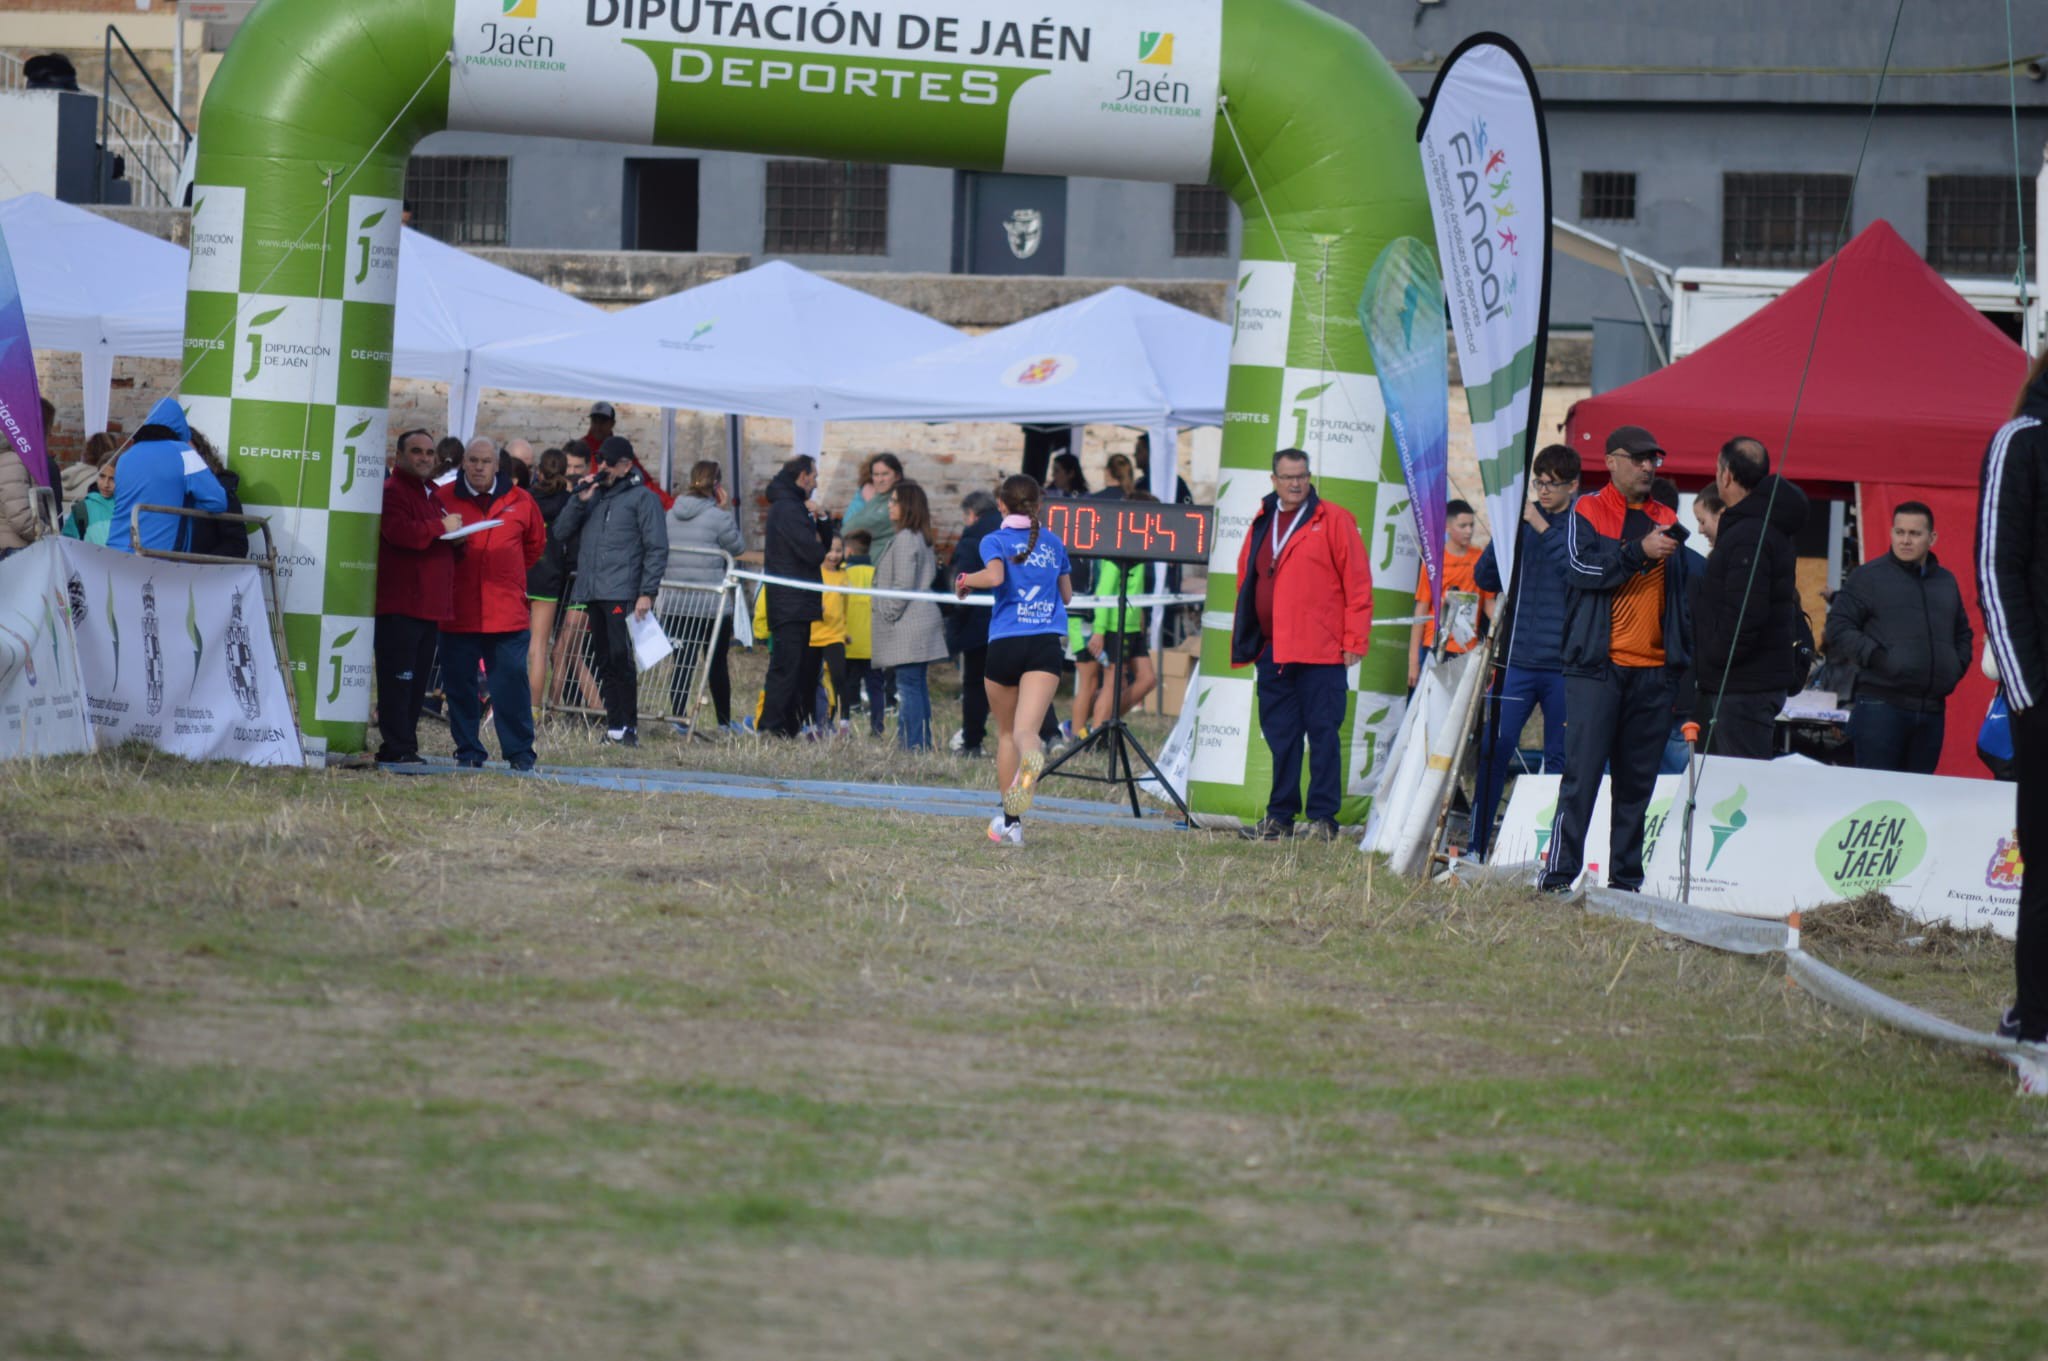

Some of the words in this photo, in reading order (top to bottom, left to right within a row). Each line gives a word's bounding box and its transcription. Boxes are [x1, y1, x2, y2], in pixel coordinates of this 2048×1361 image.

[586, 0, 882, 47] DIPUTACIÓN
[897, 14, 959, 53] DE
[970, 17, 1091, 62] JAÉN
[480, 23, 554, 57] Jaén
[465, 55, 513, 68] PARAÍSO
[514, 58, 567, 72] INTERIOR
[670, 48, 999, 105] DEPORTES
[1116, 70, 1190, 104] Jaén
[1101, 101, 1148, 115] PARAÍSO
[1149, 105, 1201, 118] INTERIOR
[264, 342, 331, 357] DIPUTACIÓN
[264, 356, 280, 366] DE
[280, 356, 309, 368] JAÉN
[1310, 418, 1376, 433] DIPUTACIÓN
[1309, 430, 1325, 441] DE
[1325, 431, 1353, 444] JAÉN
[239, 446, 320, 461] DEPORTES
[1977, 905, 1990, 914] de
[1991, 906, 2016, 917] Jaén
